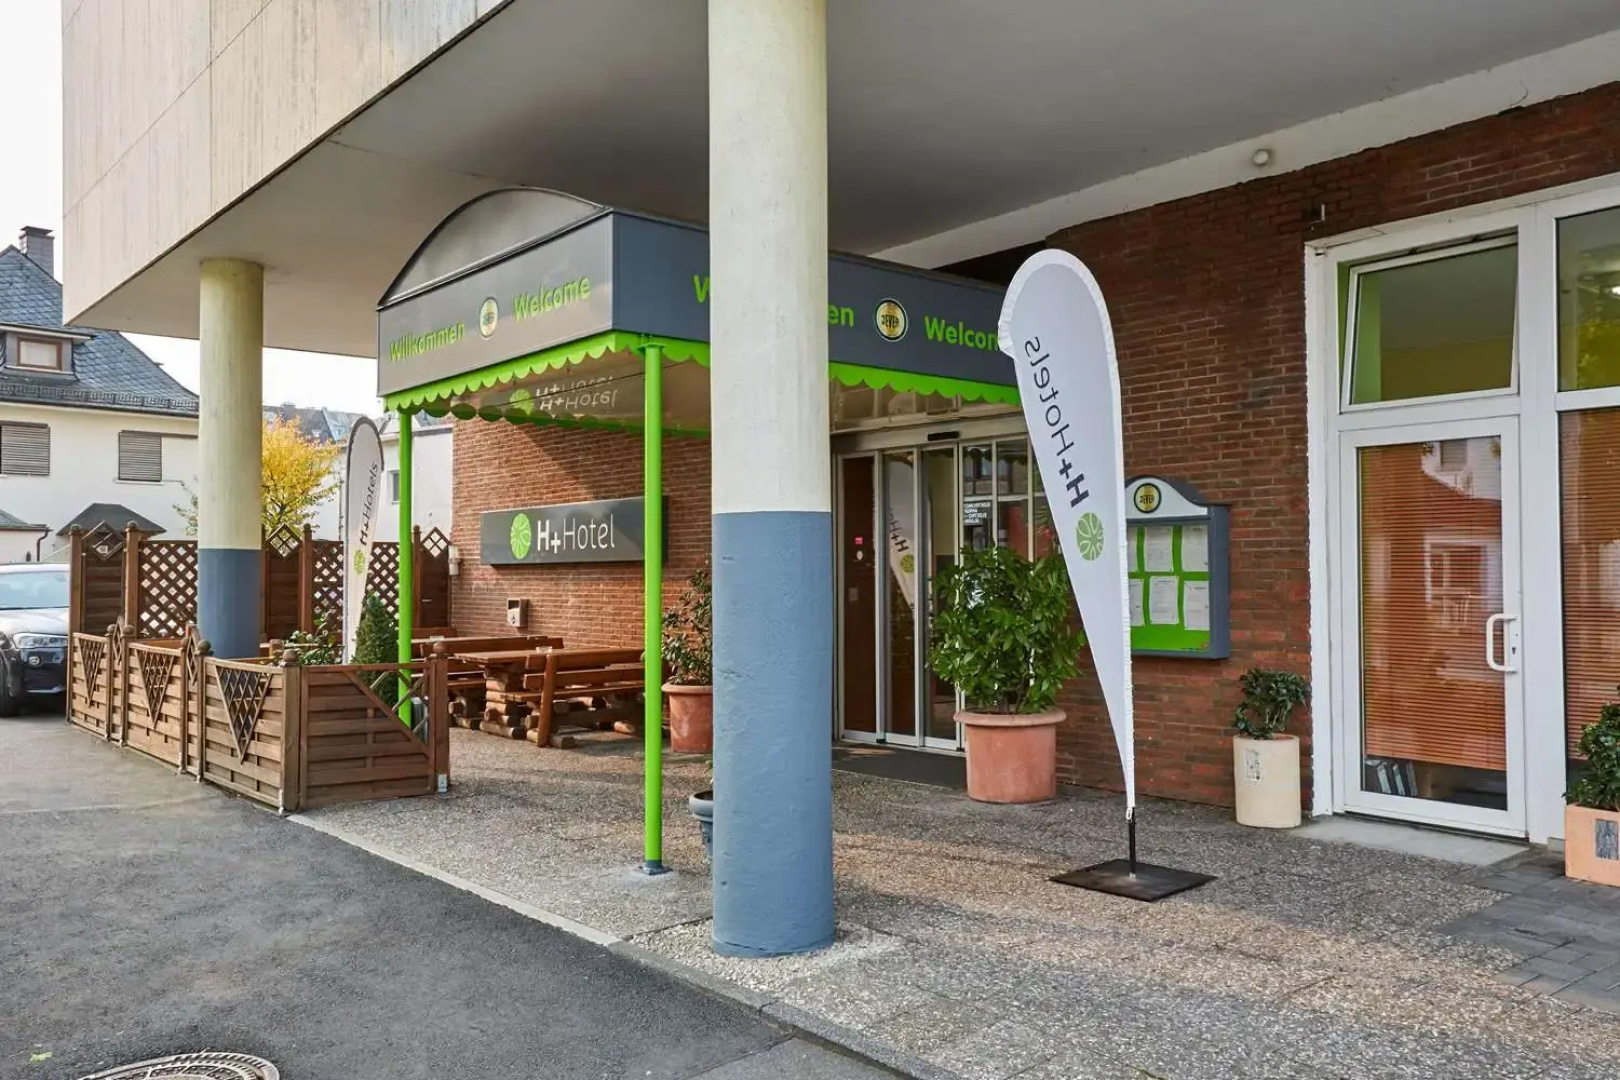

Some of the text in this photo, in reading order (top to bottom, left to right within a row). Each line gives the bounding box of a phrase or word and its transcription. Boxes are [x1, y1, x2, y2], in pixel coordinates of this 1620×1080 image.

[389, 276, 590, 362] Willkommen Welcome
[924, 315, 998, 351] Welcom
